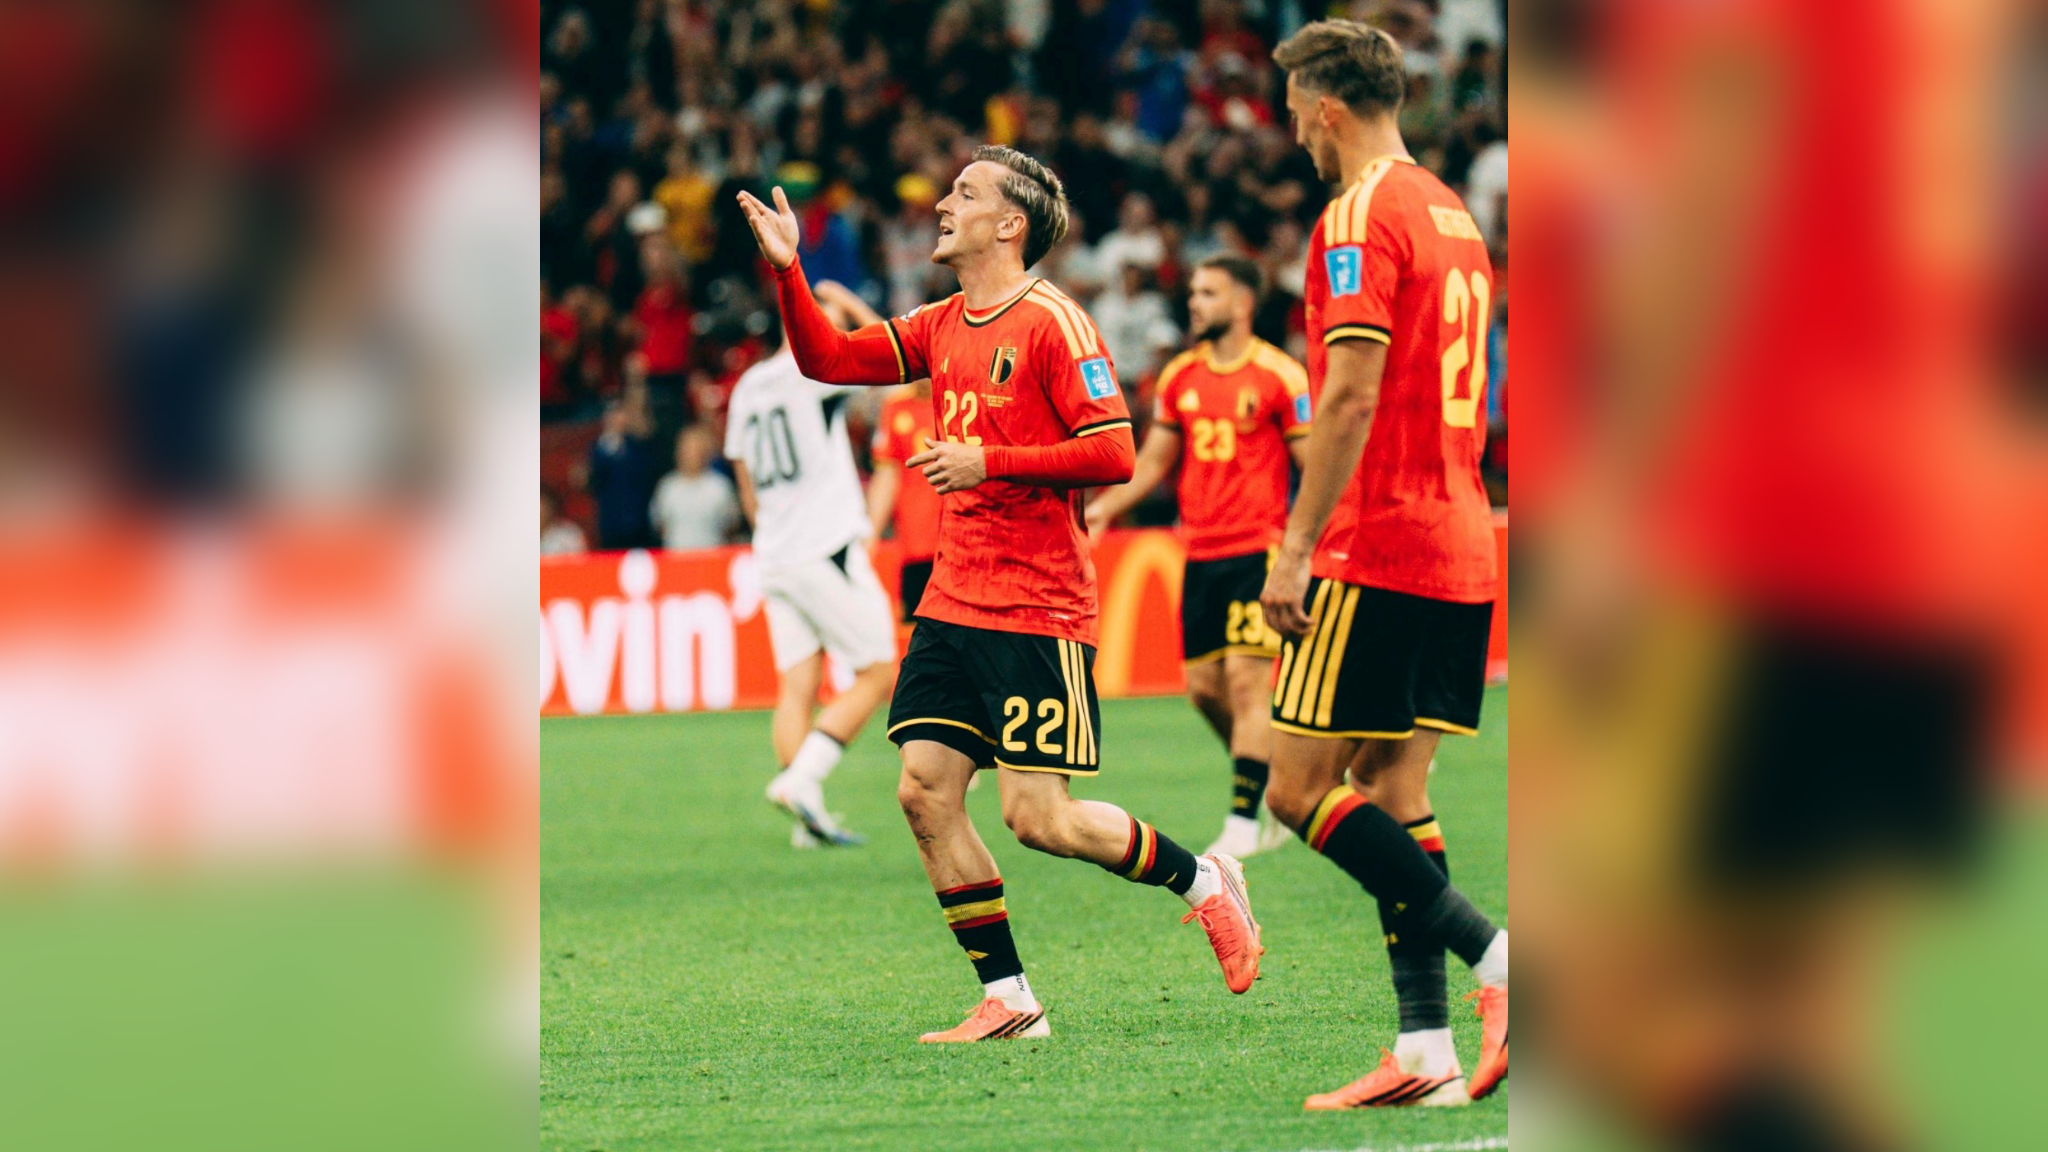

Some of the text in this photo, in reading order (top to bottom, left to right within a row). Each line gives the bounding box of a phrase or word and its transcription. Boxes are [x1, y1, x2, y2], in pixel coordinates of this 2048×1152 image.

[1441, 267, 1490, 428] 21
[746, 406, 799, 488] 20
[943, 390, 983, 446] 22
[1192, 417, 1236, 462] 23
[1225, 599, 1264, 645] 23
[1002, 695, 1065, 755] 22
